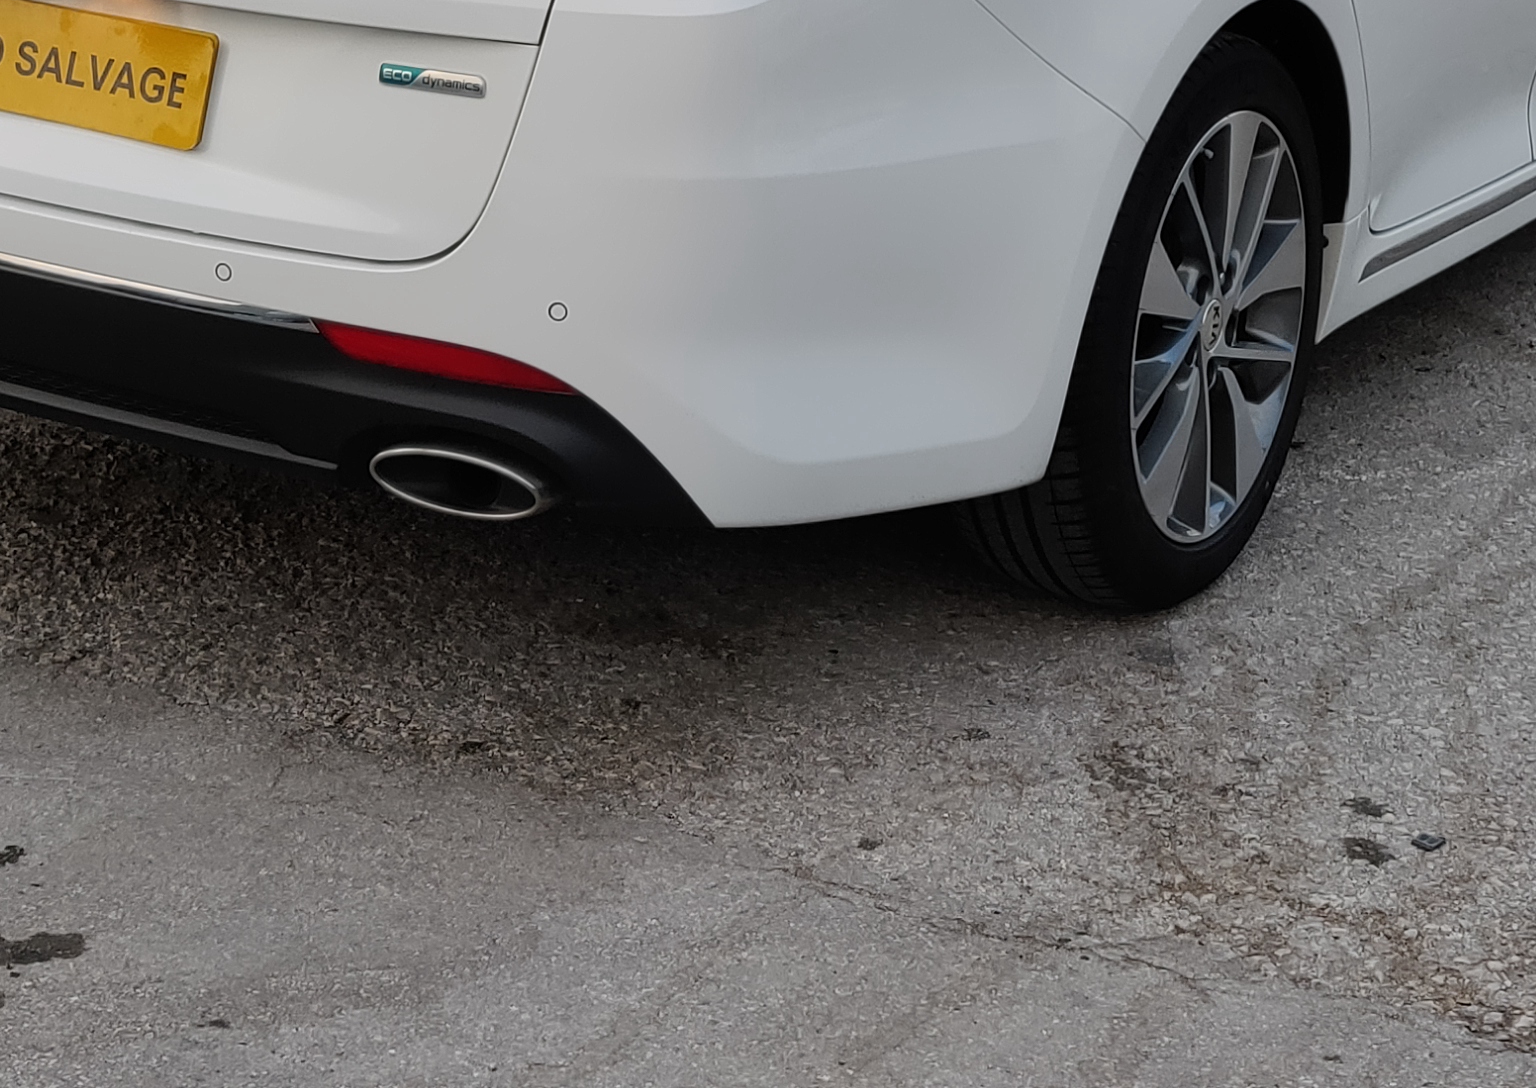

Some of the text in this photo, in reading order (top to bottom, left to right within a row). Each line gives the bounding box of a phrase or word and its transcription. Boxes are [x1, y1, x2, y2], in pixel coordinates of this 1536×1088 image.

[14, 40, 188, 110] SALVAGE
[383, 68, 481, 92] ECO dynamics
[1209, 306, 1220, 345] KIA
